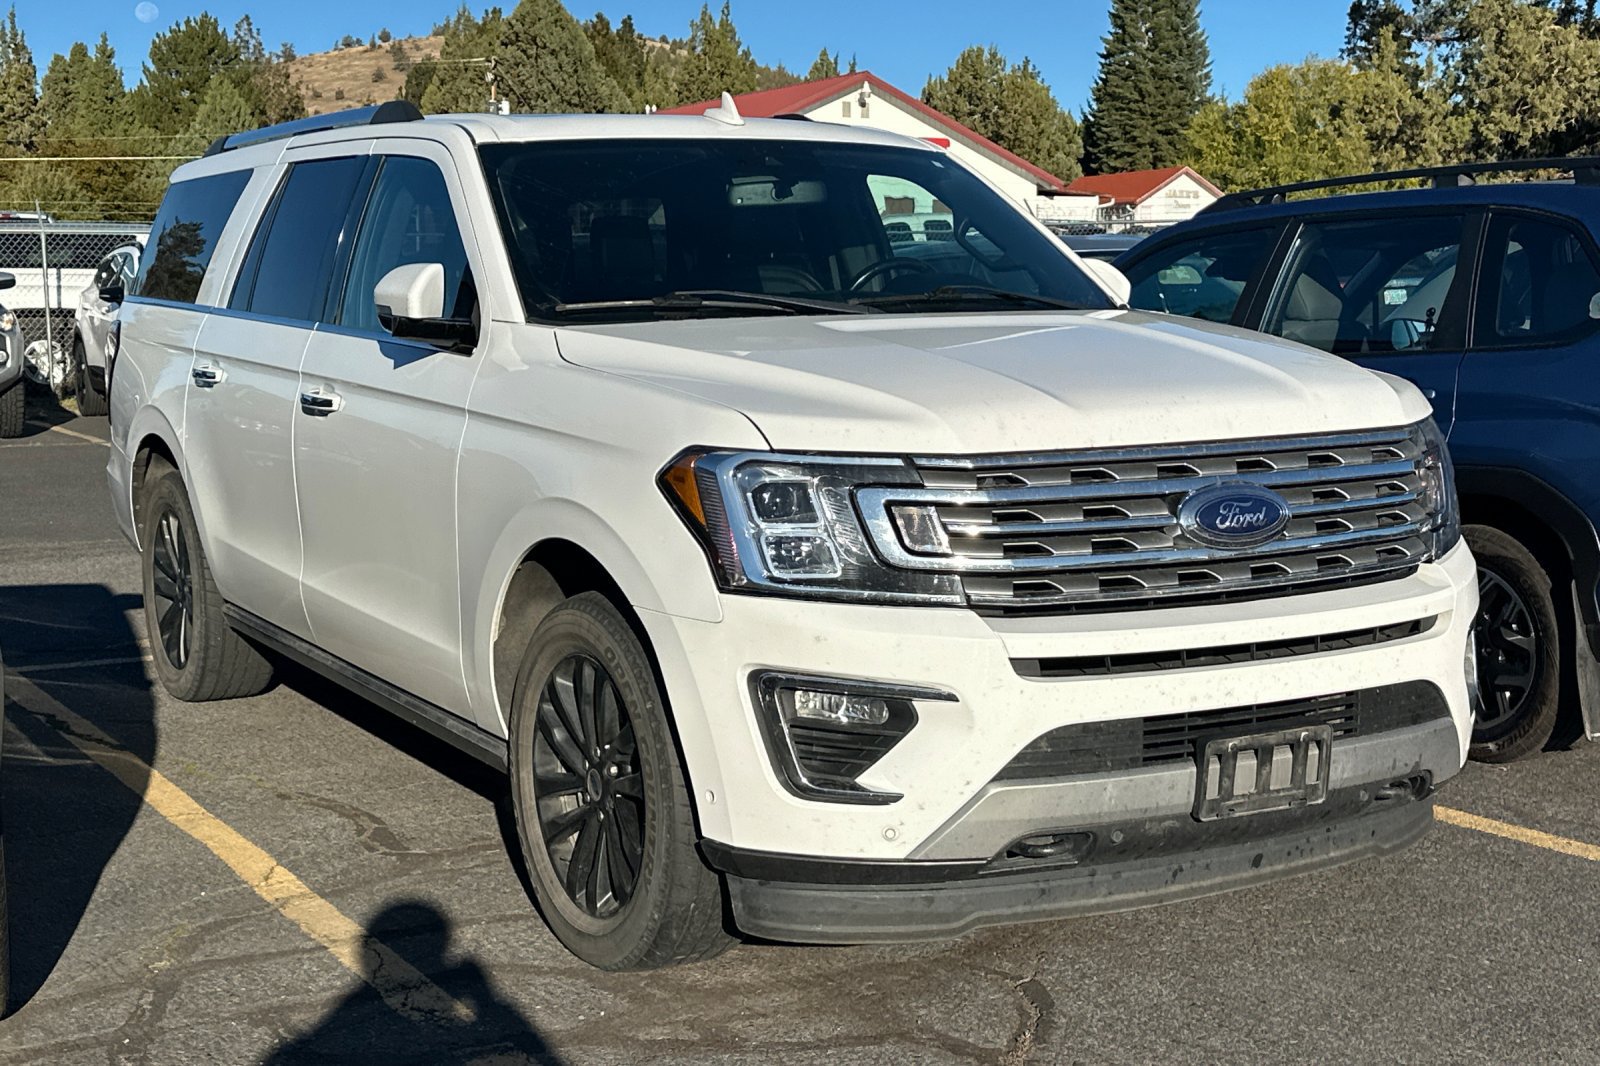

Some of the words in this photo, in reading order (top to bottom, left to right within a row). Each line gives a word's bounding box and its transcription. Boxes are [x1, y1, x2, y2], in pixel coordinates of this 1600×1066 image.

[1216, 501, 1267, 529] Ford
[604, 646, 642, 719] OPEN
[640, 736, 657, 895] COUNTRY
